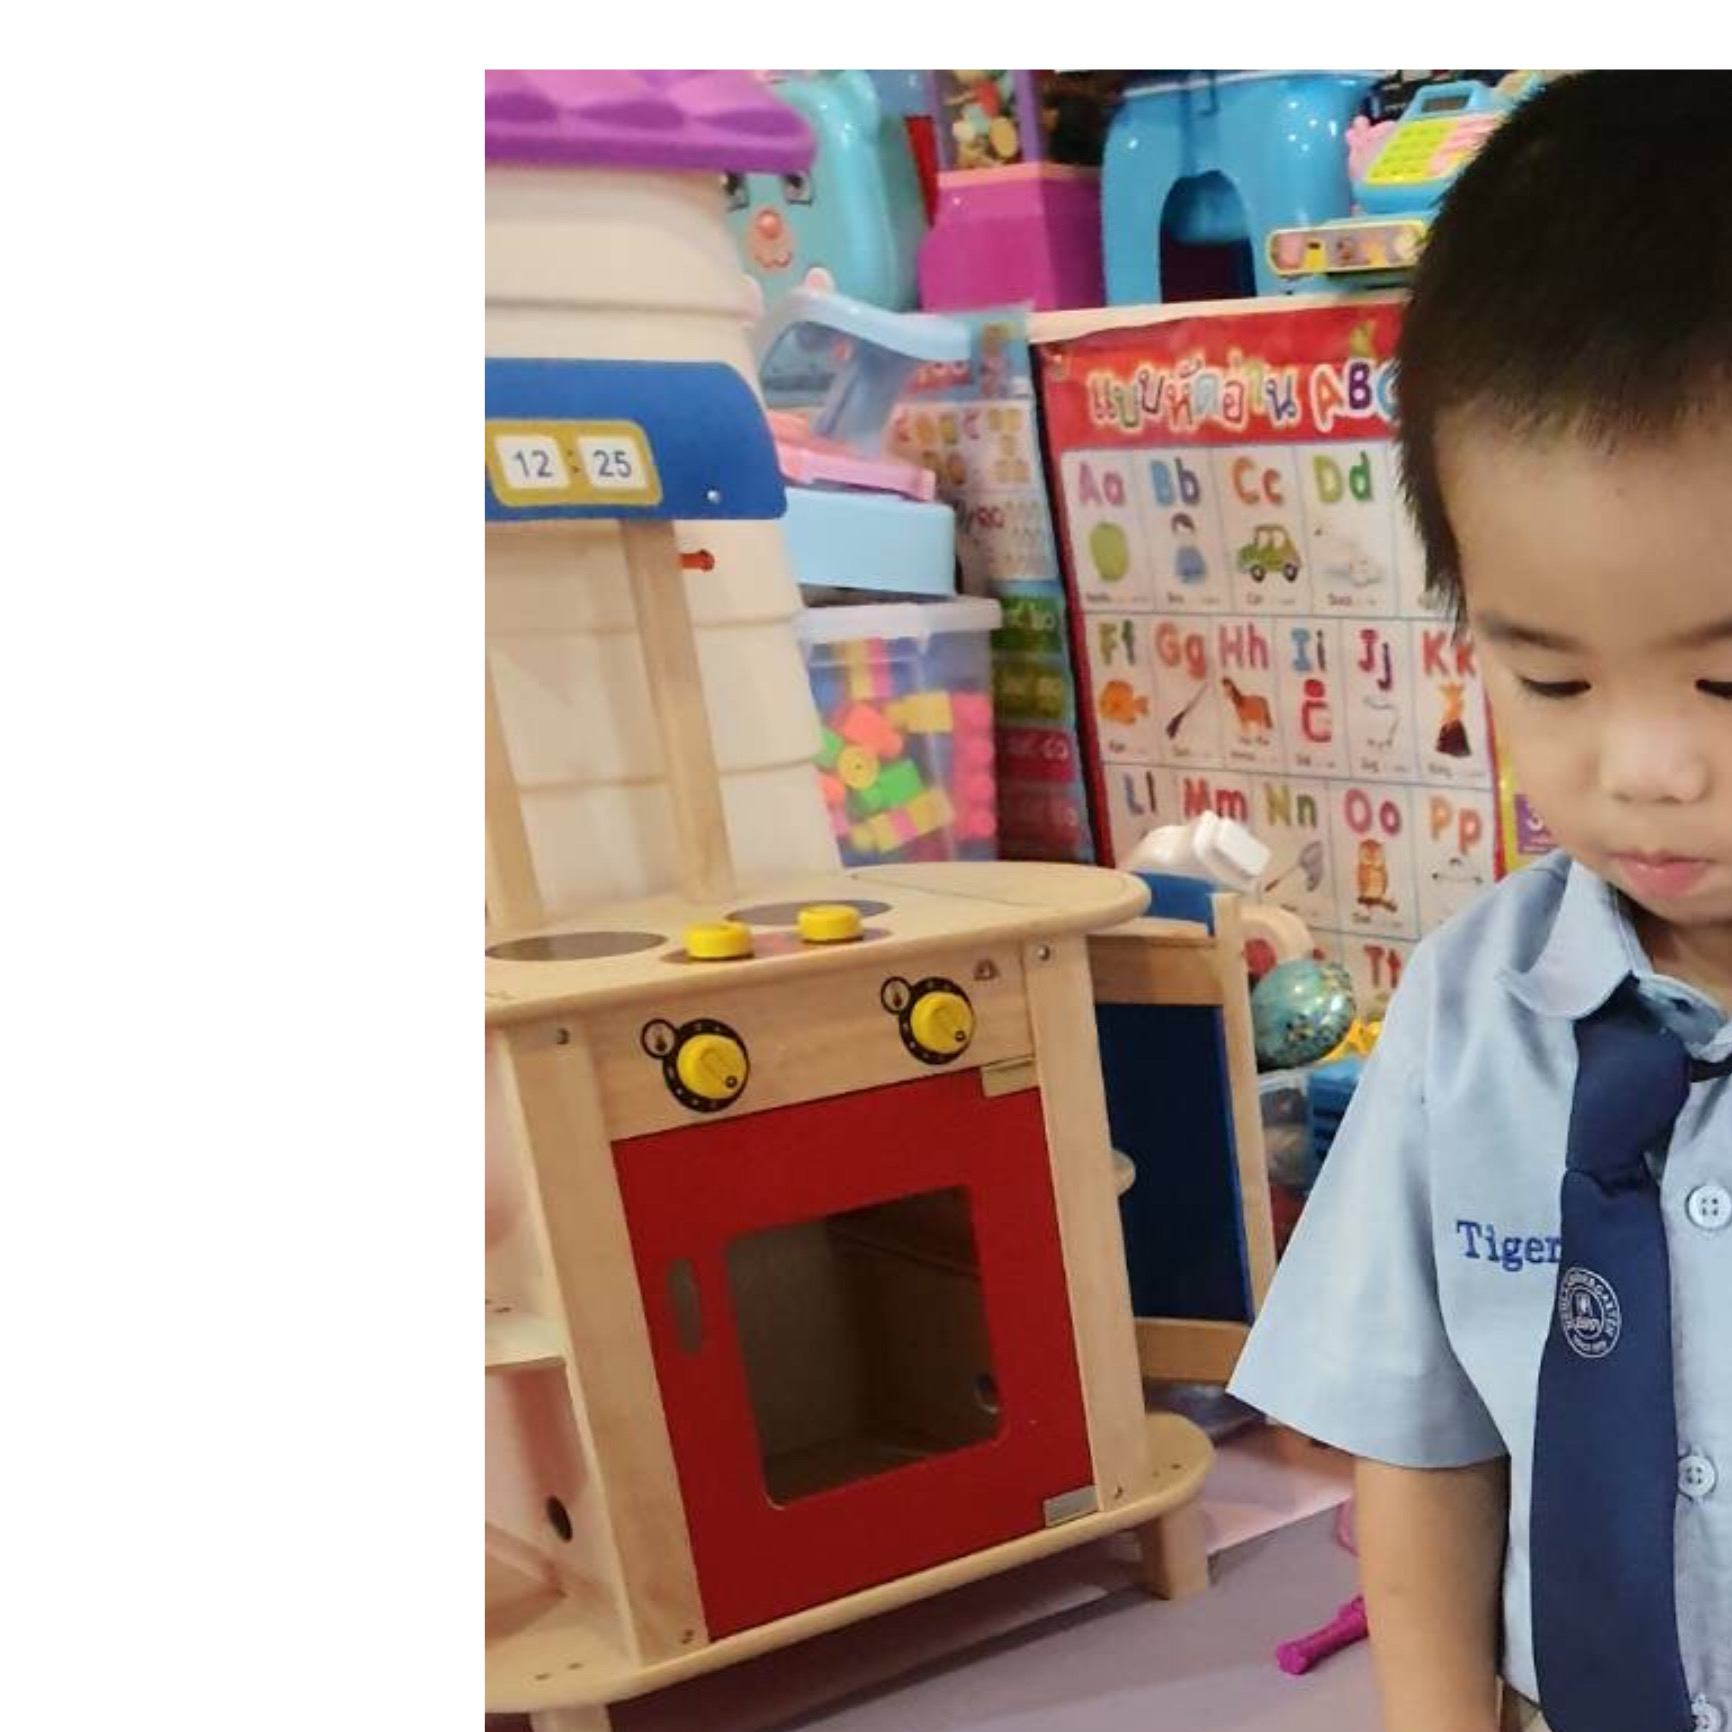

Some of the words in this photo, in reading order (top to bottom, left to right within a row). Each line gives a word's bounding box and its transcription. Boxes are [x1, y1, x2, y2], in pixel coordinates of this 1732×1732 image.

[513, 449, 553, 478] 12
[592, 449, 633, 478] 25
[1077, 461, 1126, 506] Aa
[1151, 457, 1200, 506] Bb
[1230, 455, 1284, 506] Cc
[1313, 451, 1372, 503] Dd
[1155, 621, 1207, 681] Gg
[1218, 622, 1270, 671] Hh
[1290, 627, 1326, 672] Ii
[1357, 629, 1392, 692] Jj
[1264, 781, 1318, 829] Nn
[1344, 788, 1403, 836] Oo
[1428, 795, 1483, 854] Pp
